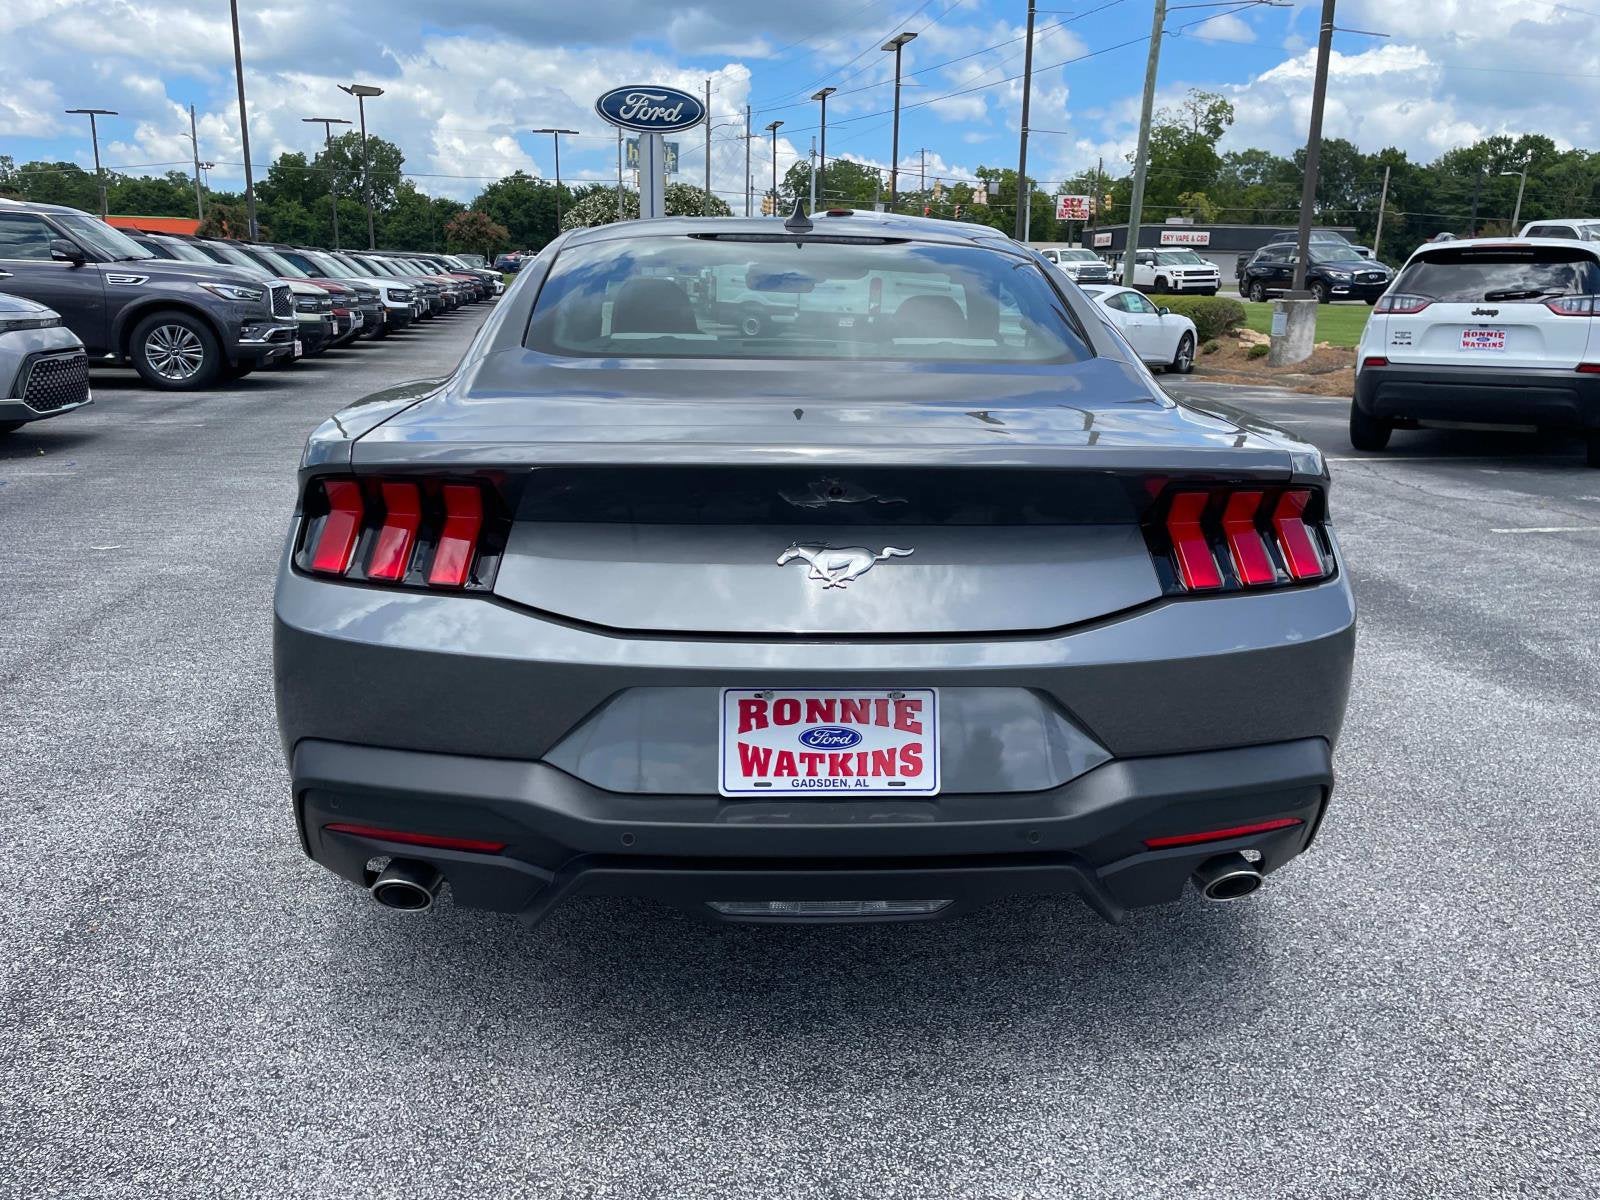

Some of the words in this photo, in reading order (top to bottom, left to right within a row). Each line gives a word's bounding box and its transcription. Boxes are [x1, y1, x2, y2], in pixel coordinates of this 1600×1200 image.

[619, 92, 684, 122] Ford
[1471, 308, 1499, 317] Jeep
[1463, 331, 1505, 339] RONNIE
[738, 698, 923, 735] RONNIE
[809, 728, 852, 746] Ford
[737, 741, 923, 778] WATKINS
[791, 778, 851, 789] GADSDEN,
[855, 778, 870, 788] AL
